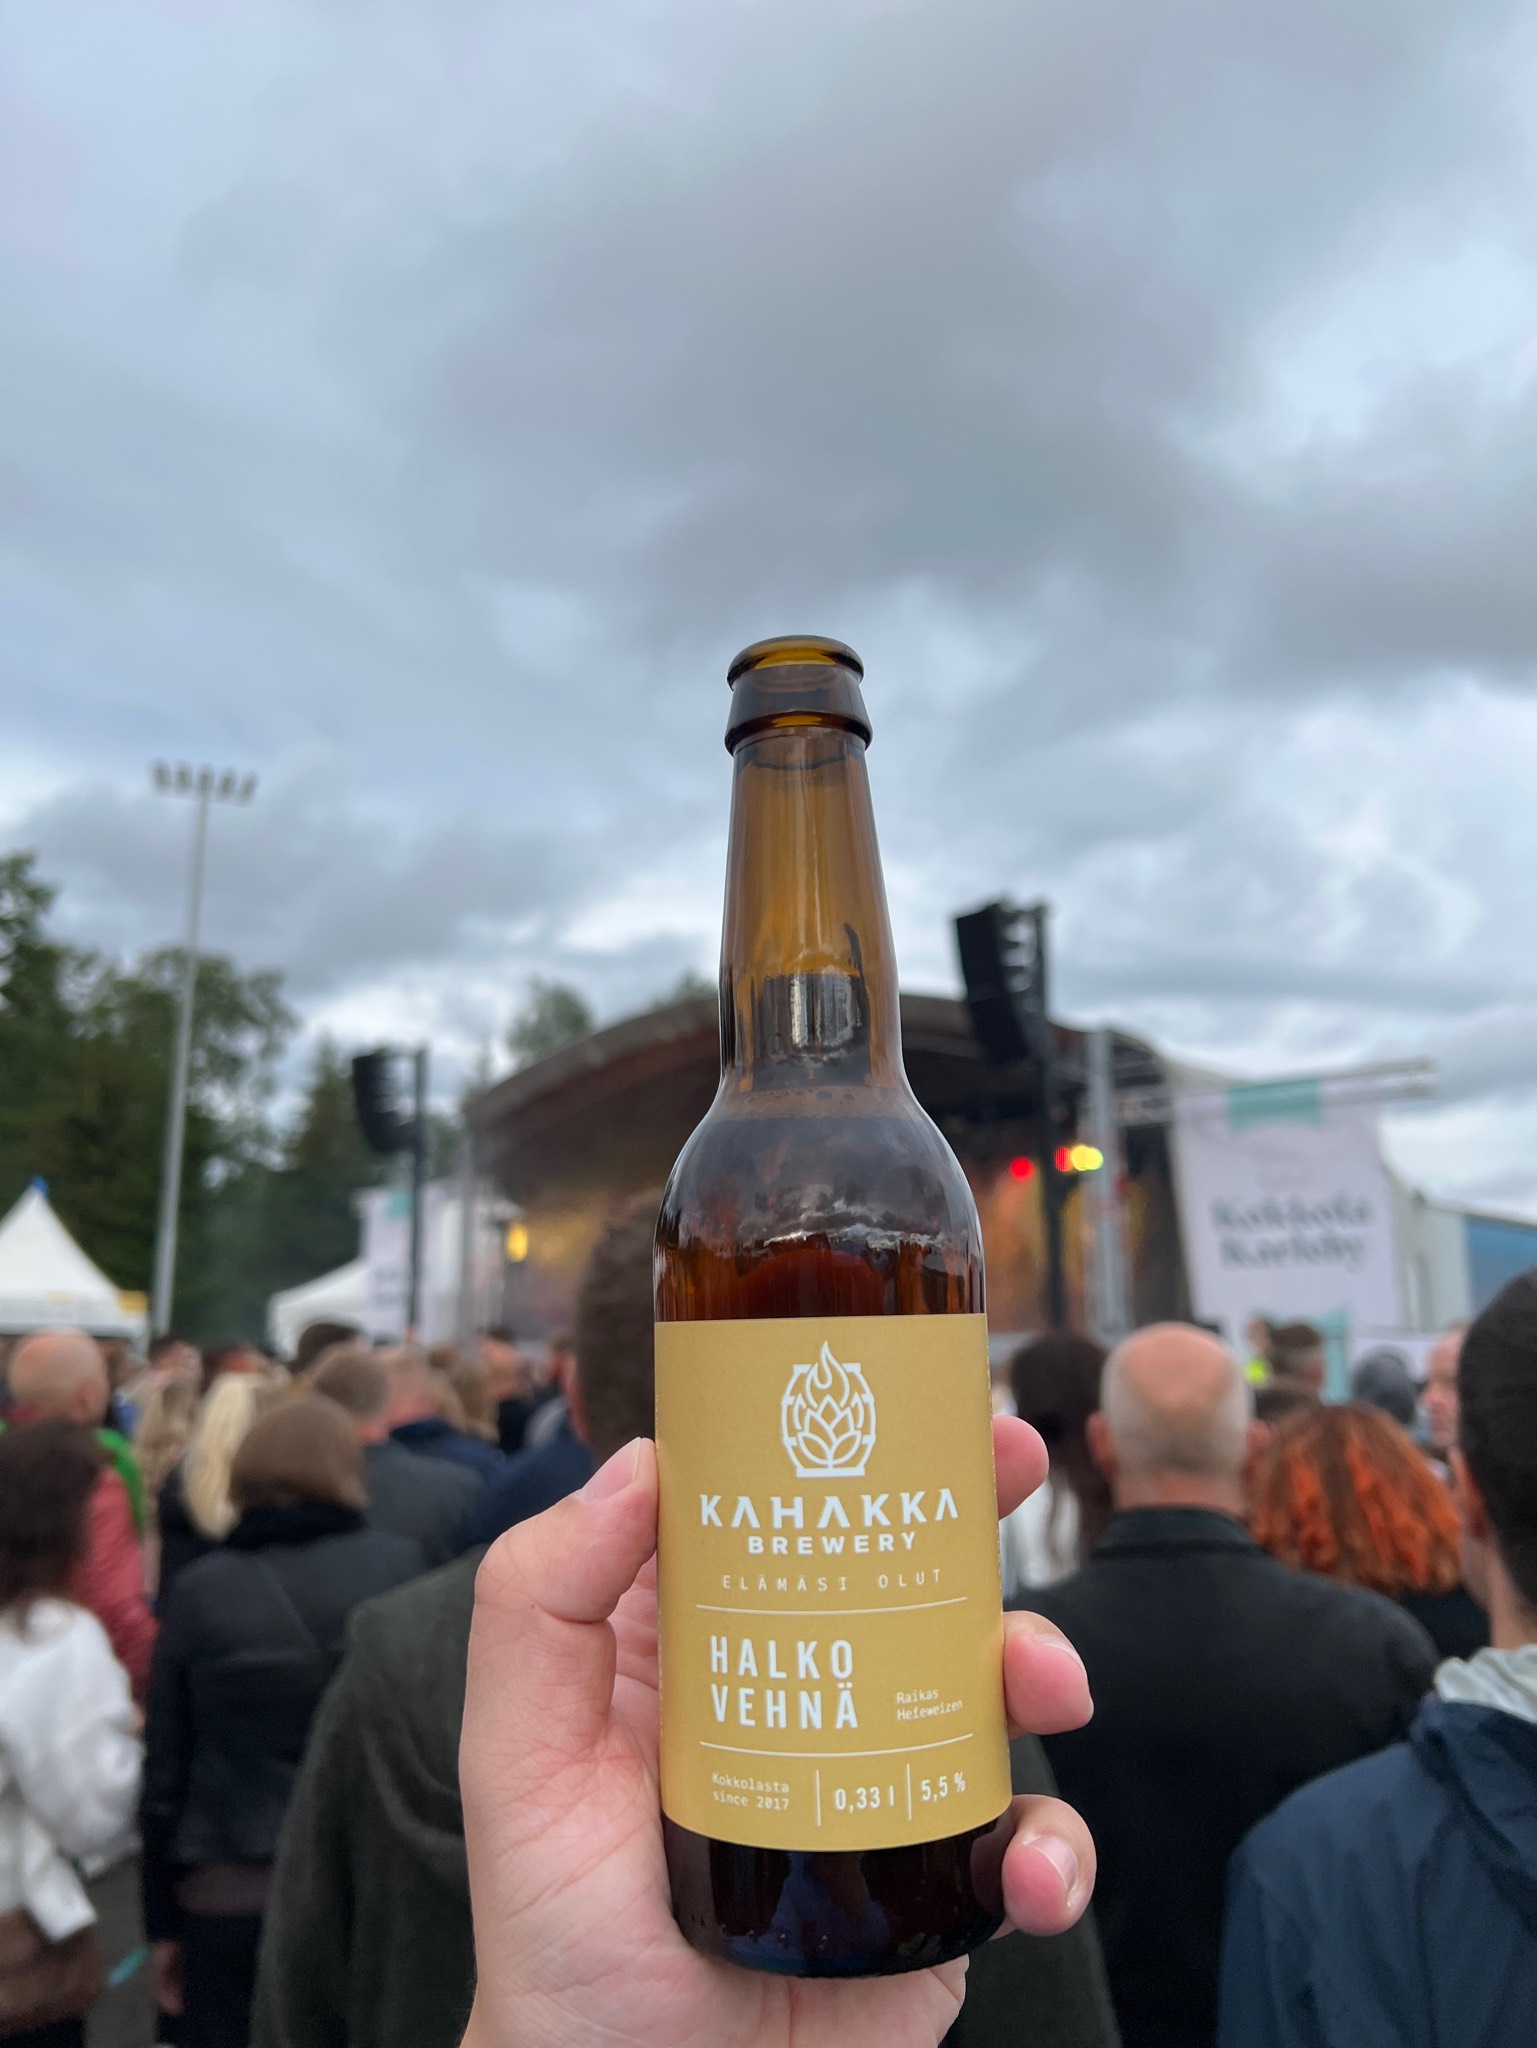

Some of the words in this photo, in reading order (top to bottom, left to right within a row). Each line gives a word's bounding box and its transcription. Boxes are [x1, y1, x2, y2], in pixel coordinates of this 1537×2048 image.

[699, 1487, 959, 1529] KAHAKKA
[748, 1531, 917, 1554] BREWERY
[722, 1573, 848, 1592] ELÄMÄSI
[878, 1568, 942, 1589] OLUT
[711, 1635, 853, 1679] HALKO
[711, 1682, 859, 1730] VEHNÄ
[896, 1688, 940, 1705] Raikas
[896, 1699, 964, 1721] Hefeweizen
[712, 1772, 790, 1794] Kokkolasta
[921, 1777, 949, 1803] 5,5
[954, 1771, 967, 1792] %
[712, 1791, 749, 1807] since
[756, 1796, 790, 1811] 2017
[834, 1786, 881, 1812] 0,33
